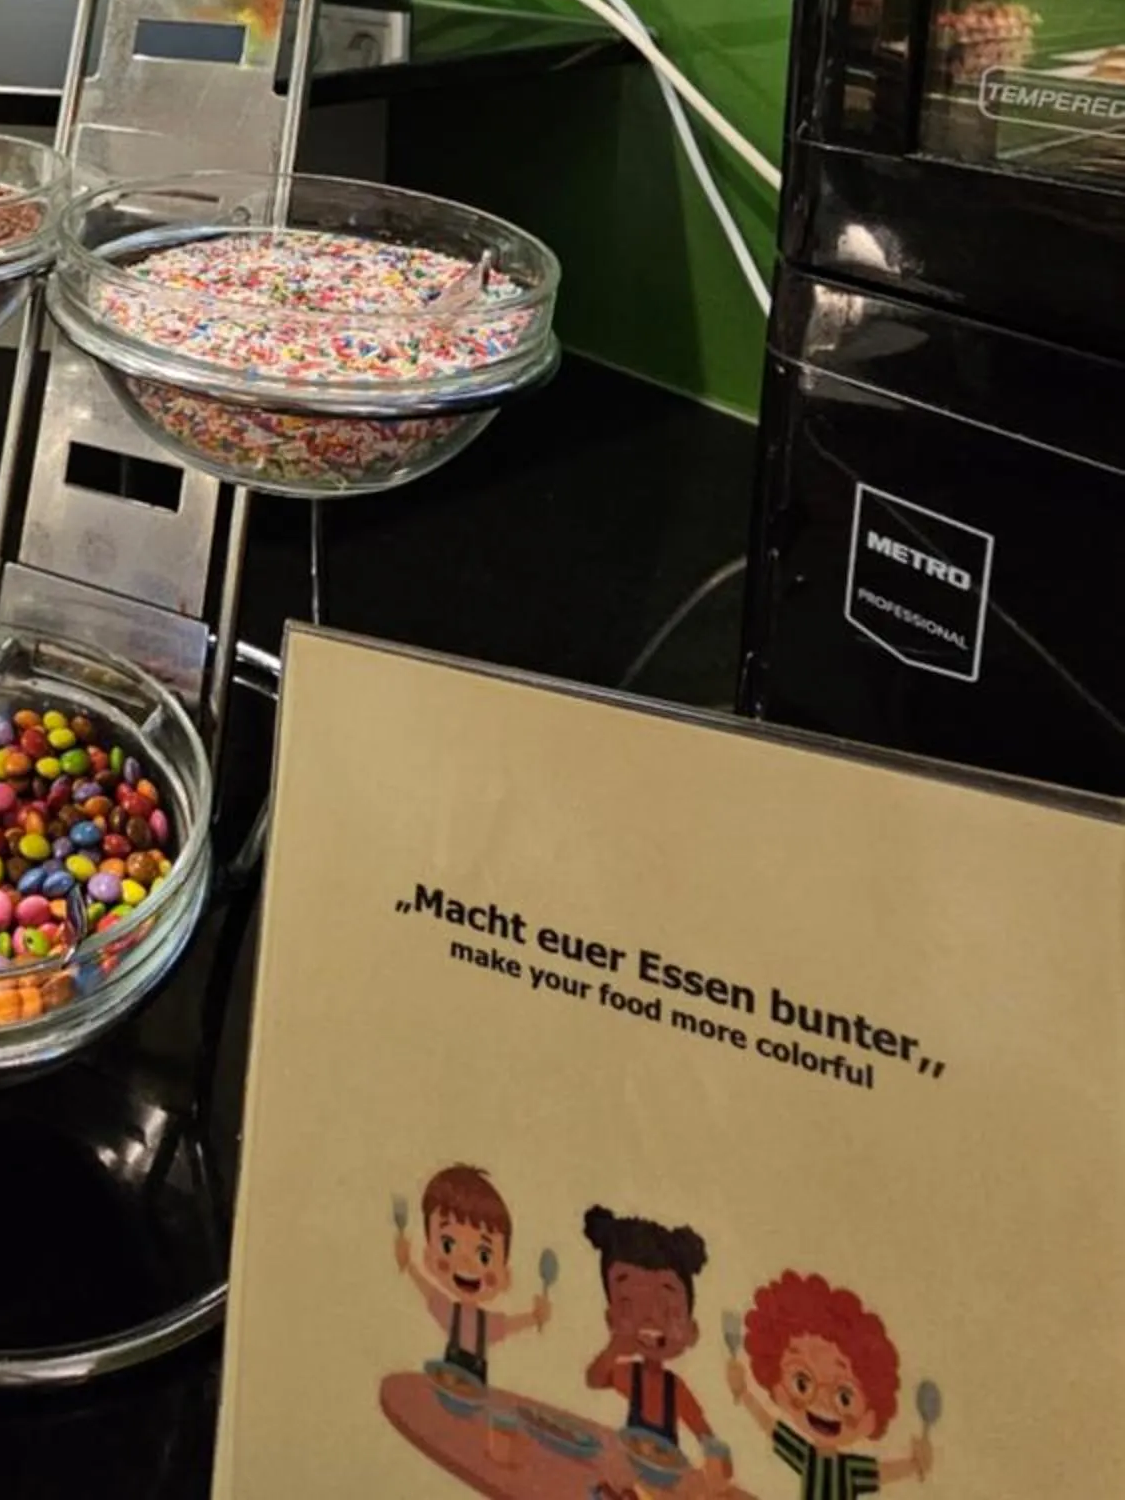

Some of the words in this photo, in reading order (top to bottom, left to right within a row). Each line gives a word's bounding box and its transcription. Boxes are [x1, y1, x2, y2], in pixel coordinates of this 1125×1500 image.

[867, 529, 972, 591] METRO
[858, 587, 969, 651] PROFESSIONAL
[536, 927, 627, 973] euer
[638, 949, 756, 1014] Essen
[450, 940, 522, 979] make
[528, 965, 593, 1000] your
[598, 982, 662, 1024] food
[670, 1009, 748, 1050] more
[755, 1034, 874, 1090] colorful
